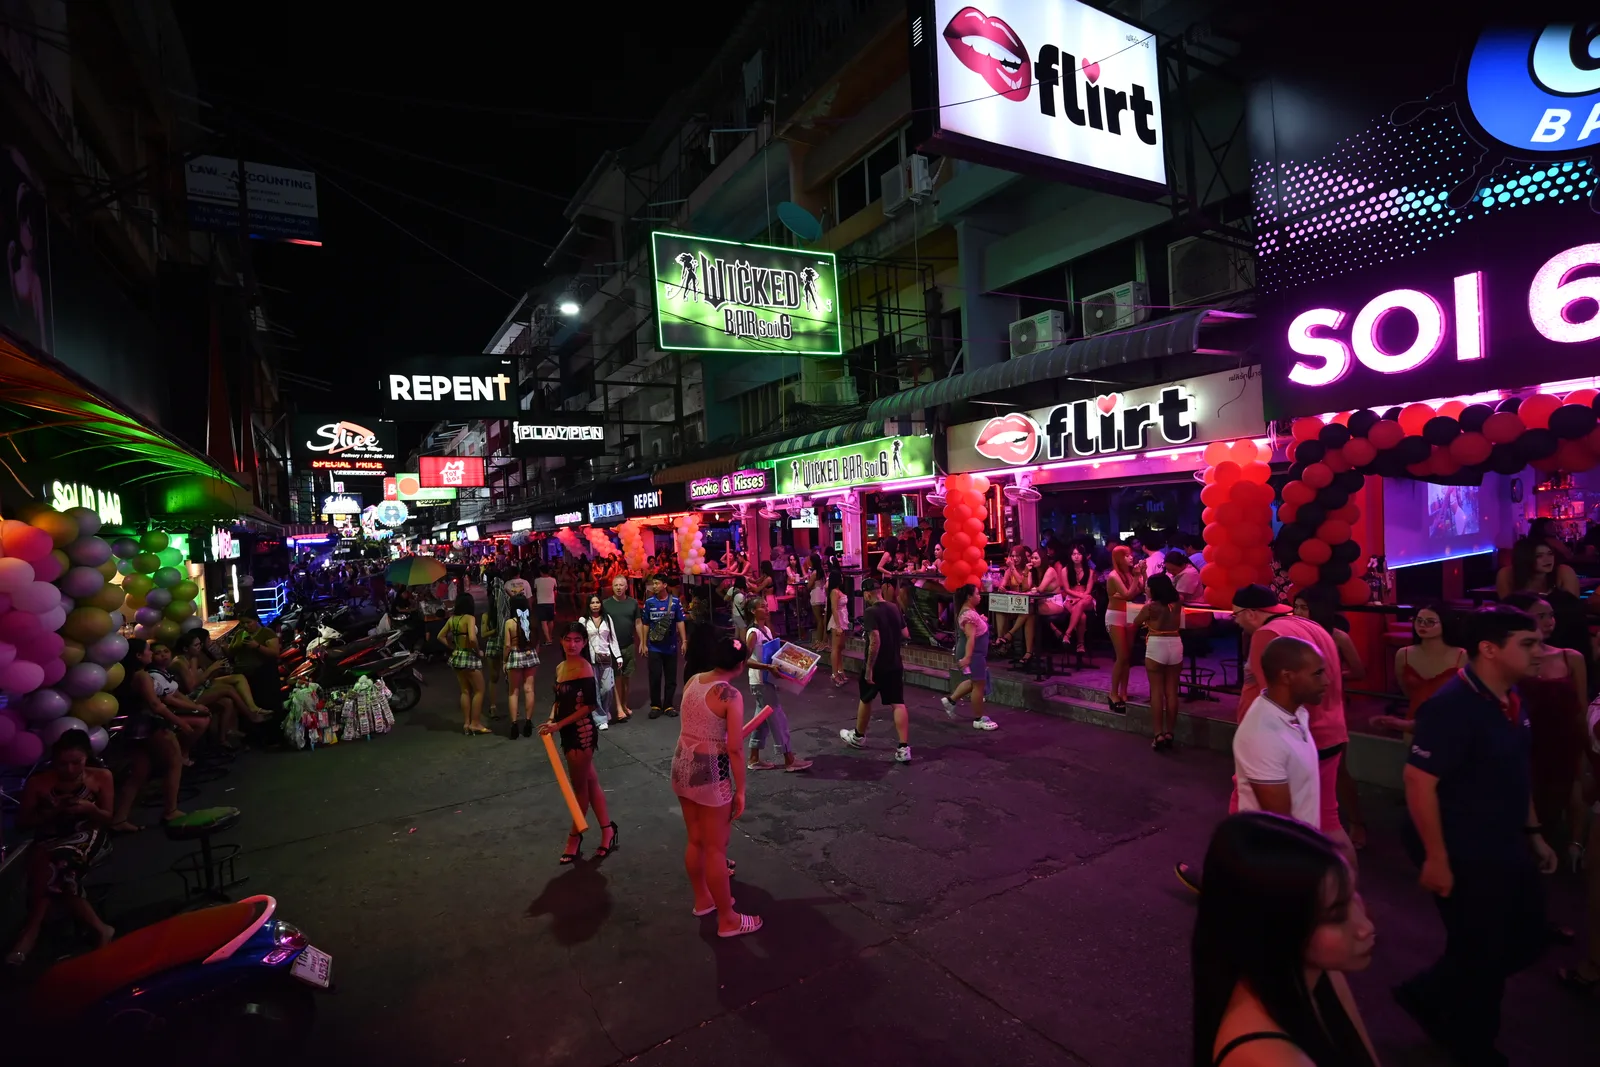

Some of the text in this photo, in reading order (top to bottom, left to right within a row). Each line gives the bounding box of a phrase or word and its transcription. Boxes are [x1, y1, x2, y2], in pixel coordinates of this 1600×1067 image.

[1033, 43, 1157, 146] flirt
[190, 165, 217, 176] LAW
[231, 170, 312, 190] ACOUNTING
[698, 250, 800, 311] WICKED
[724, 307, 758, 338] BAR
[1287, 242, 1600, 388] SOI 6
[389, 373, 510, 401] REPENT
[306, 422, 379, 452] Slice
[520, 425, 604, 440] PLAYPEN
[1046, 385, 1197, 460] flirt
[312, 460, 383, 469] SPECIAL PRICE
[803, 458, 839, 489] WICKED
[842, 454, 863, 483] BAR
[388, 484, 397, 495] B
[634, 489, 662, 509] REPENT
[691, 474, 764, 498] Smoke & Kisses
[53, 481, 123, 526] SOLID BAR
